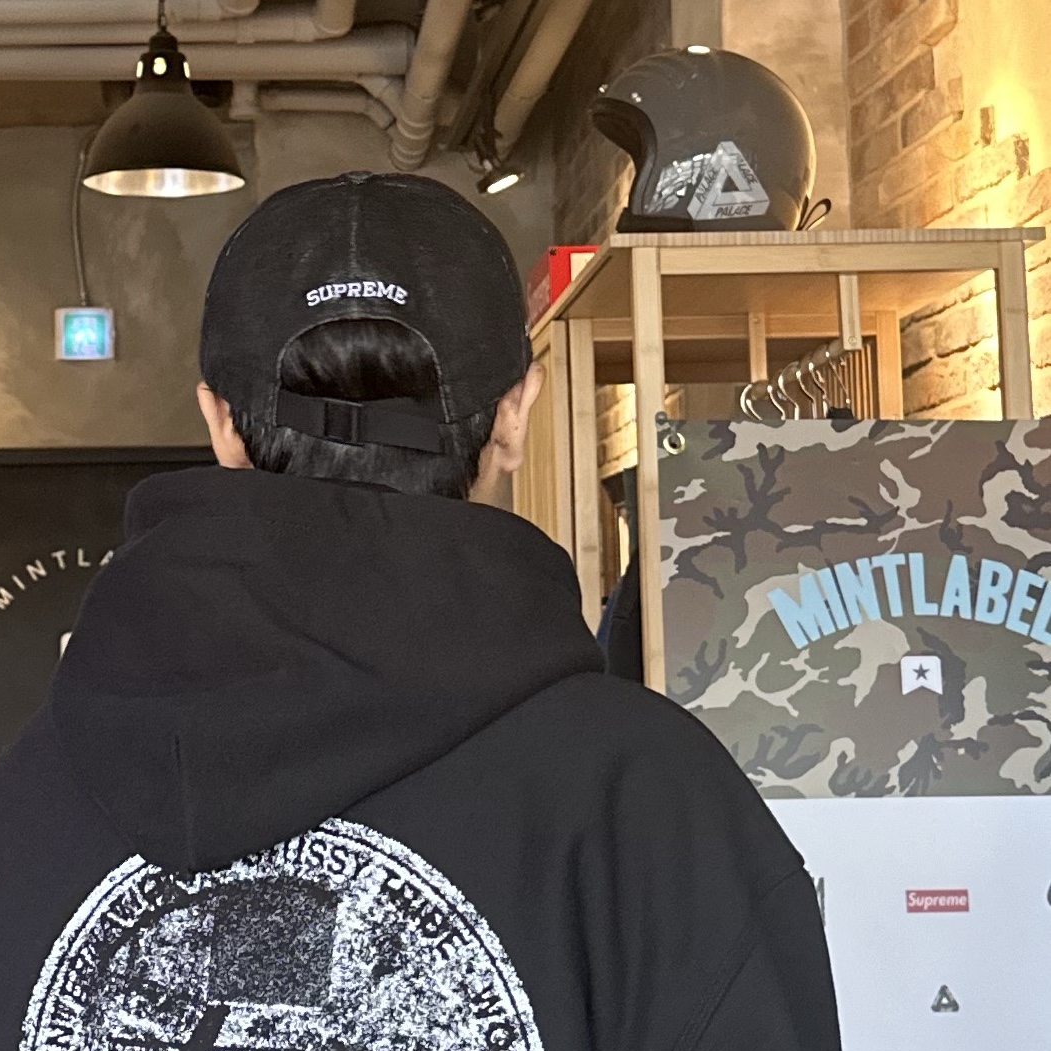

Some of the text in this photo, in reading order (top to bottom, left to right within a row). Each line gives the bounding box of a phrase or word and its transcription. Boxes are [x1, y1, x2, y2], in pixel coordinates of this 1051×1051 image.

[715, 204, 753, 217] PALACE
[306, 281, 408, 307] SUPREME
[767, 552, 1051, 649] MINTLABEL
[907, 892, 967, 911] Supreme
